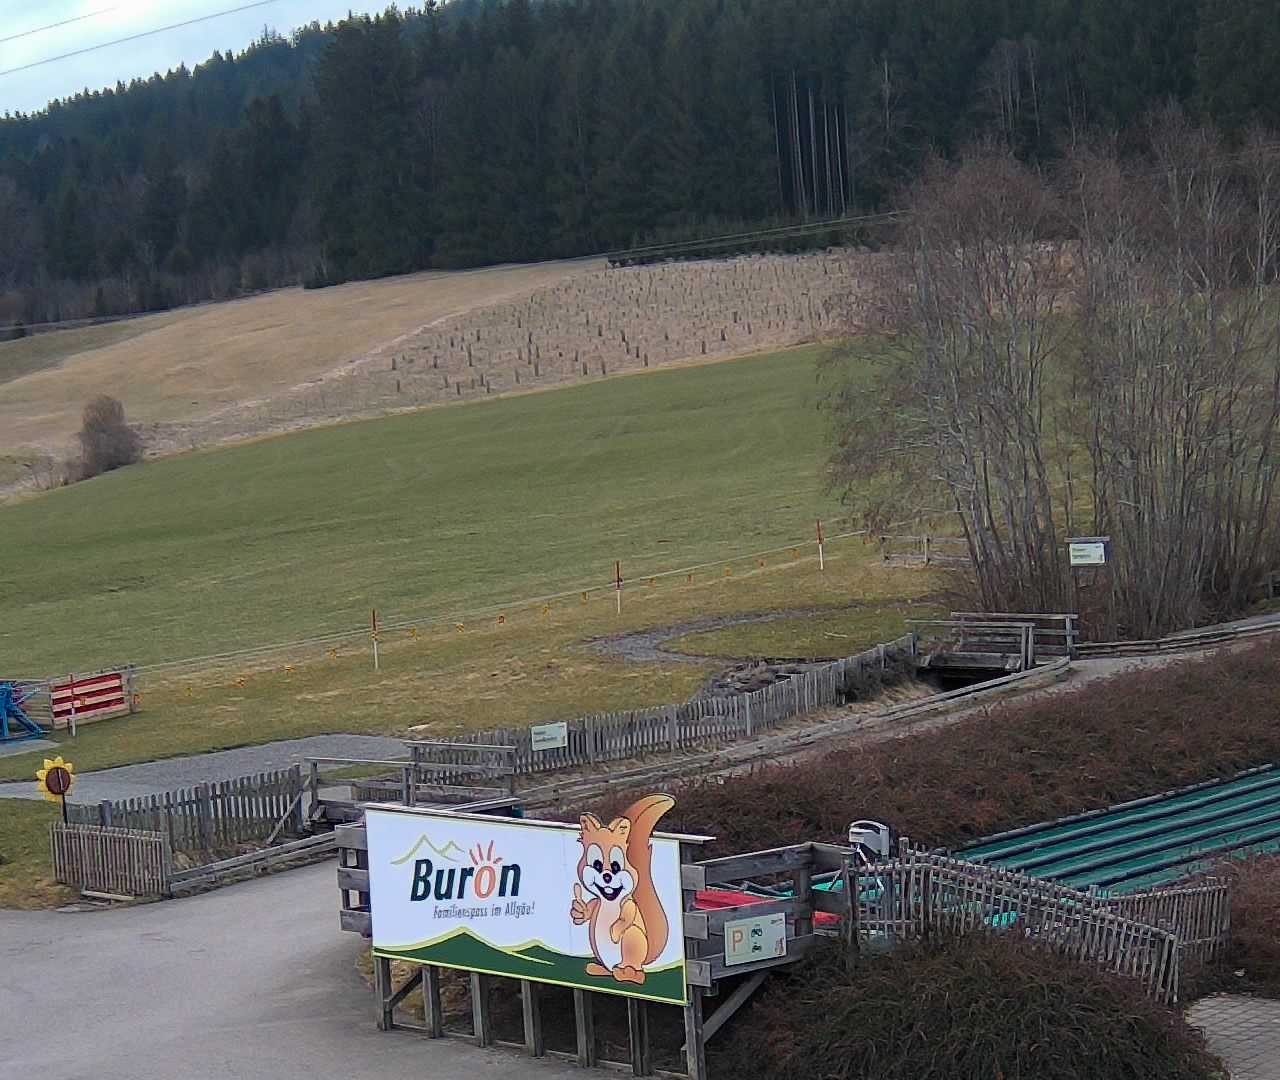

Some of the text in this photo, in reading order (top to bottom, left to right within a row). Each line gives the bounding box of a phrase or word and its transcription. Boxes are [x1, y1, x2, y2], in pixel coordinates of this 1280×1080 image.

[410, 859, 521, 901] Buron
[491, 904, 502, 917] im
[733, 930, 744, 953] P
